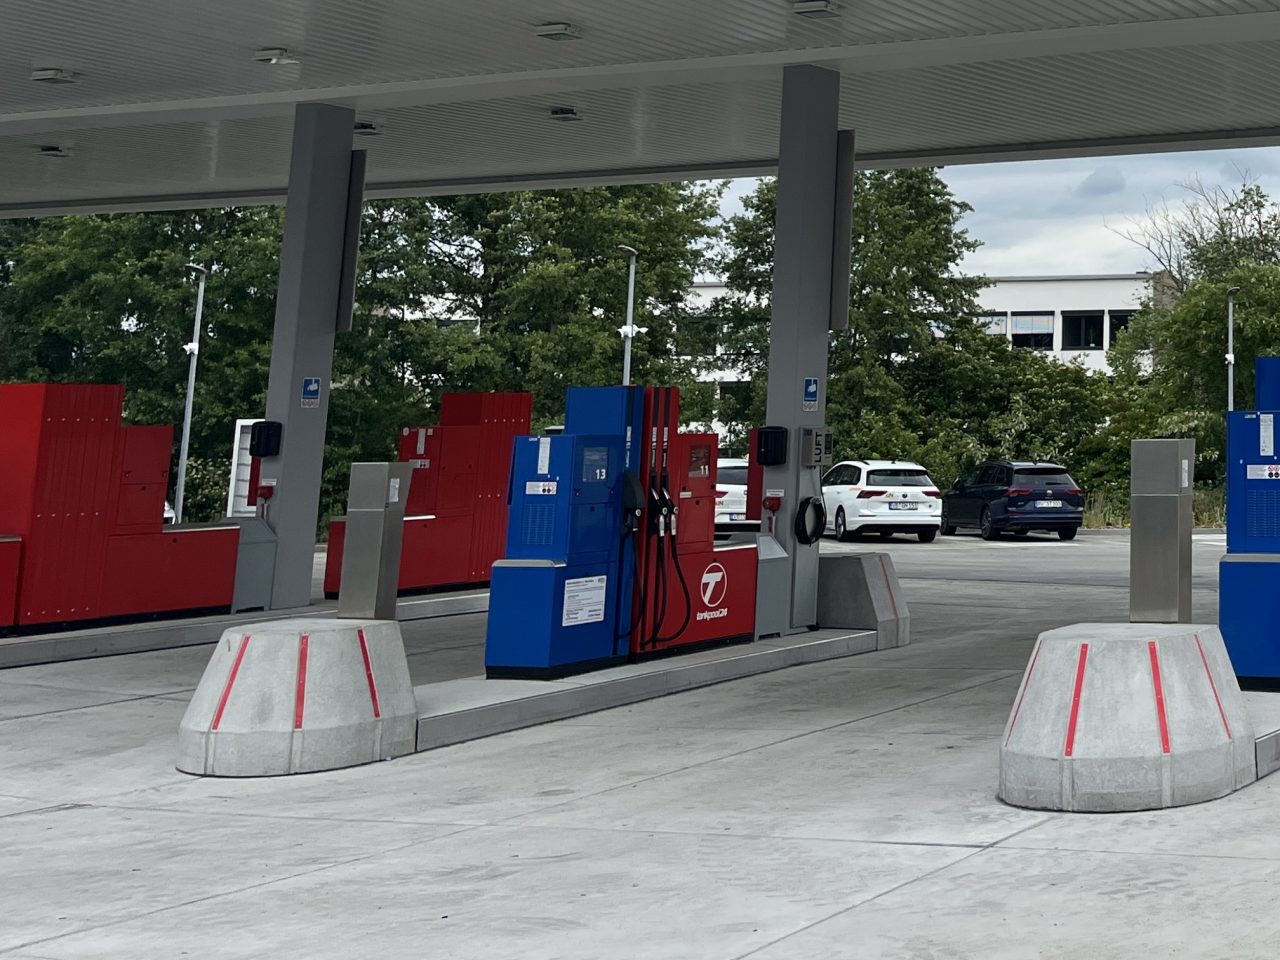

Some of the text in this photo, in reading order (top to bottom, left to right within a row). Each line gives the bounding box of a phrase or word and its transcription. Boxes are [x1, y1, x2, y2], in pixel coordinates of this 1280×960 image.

[814, 431, 823, 463] LUFT
[595, 468, 607, 480] 13
[700, 465, 709, 476] 11
